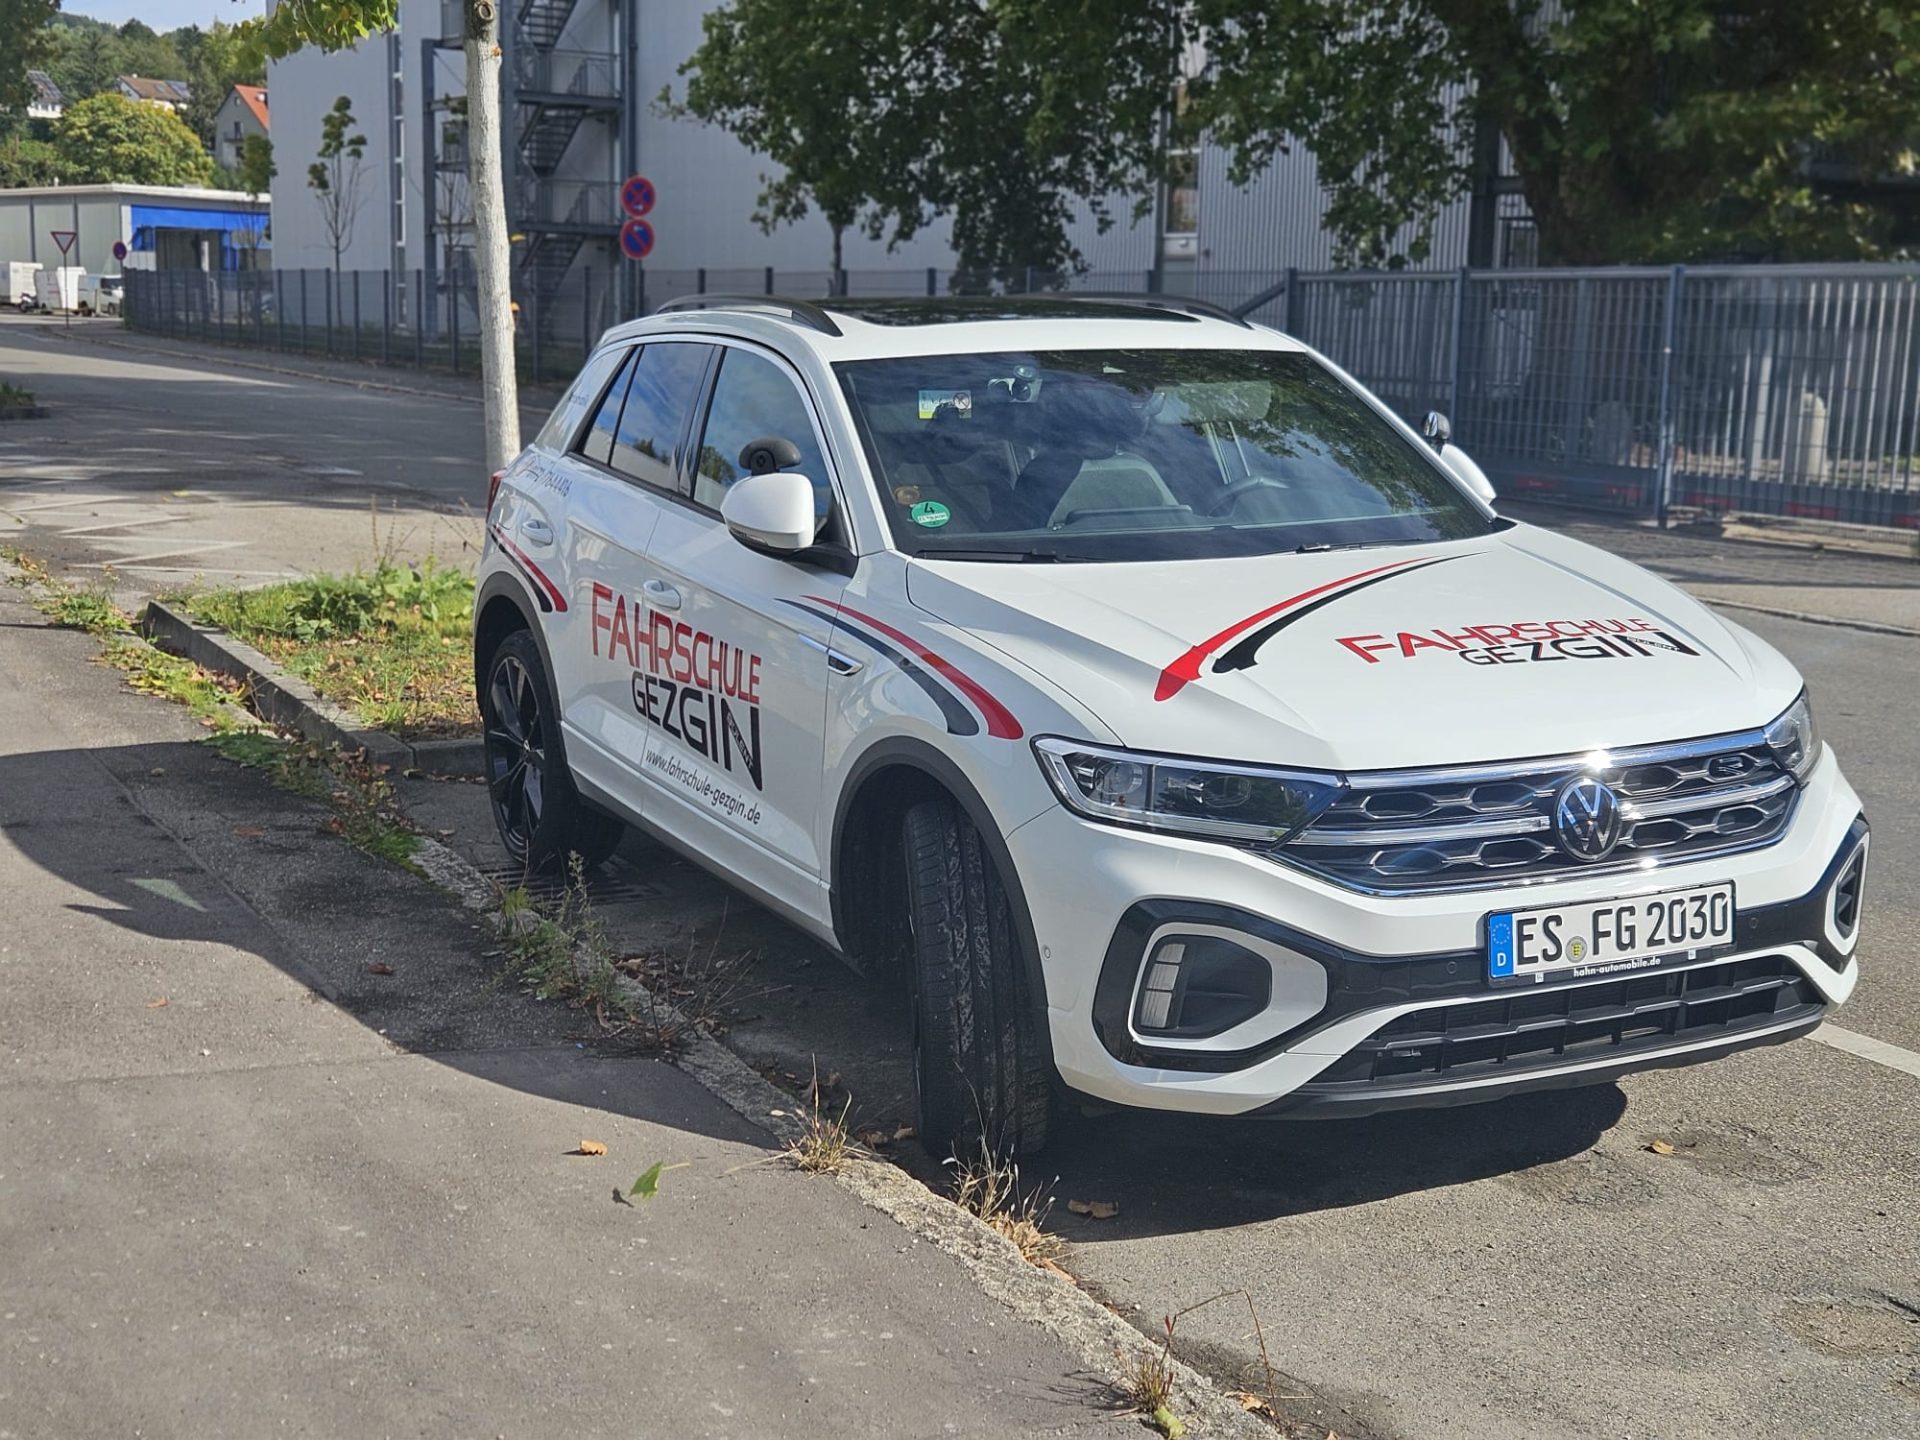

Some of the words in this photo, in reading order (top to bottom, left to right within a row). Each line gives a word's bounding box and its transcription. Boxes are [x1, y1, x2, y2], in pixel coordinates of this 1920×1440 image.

[924, 502, 935, 514] 4
[593, 582, 761, 705] FAHRSCHULE
[1335, 618, 1660, 664] FAHRSCHULE
[1458, 632, 1701, 666] GEZGIN
[632, 671, 763, 791] GEZGIN
[645, 750, 761, 825] www.fahrschule-gezgin.de
[1516, 914, 1563, 967] ES
[1592, 905, 1636, 956] FG
[1646, 892, 1729, 948] 2030
[1496, 952, 1507, 967] D
[1573, 956, 1661, 977] hahn-automobile.de
